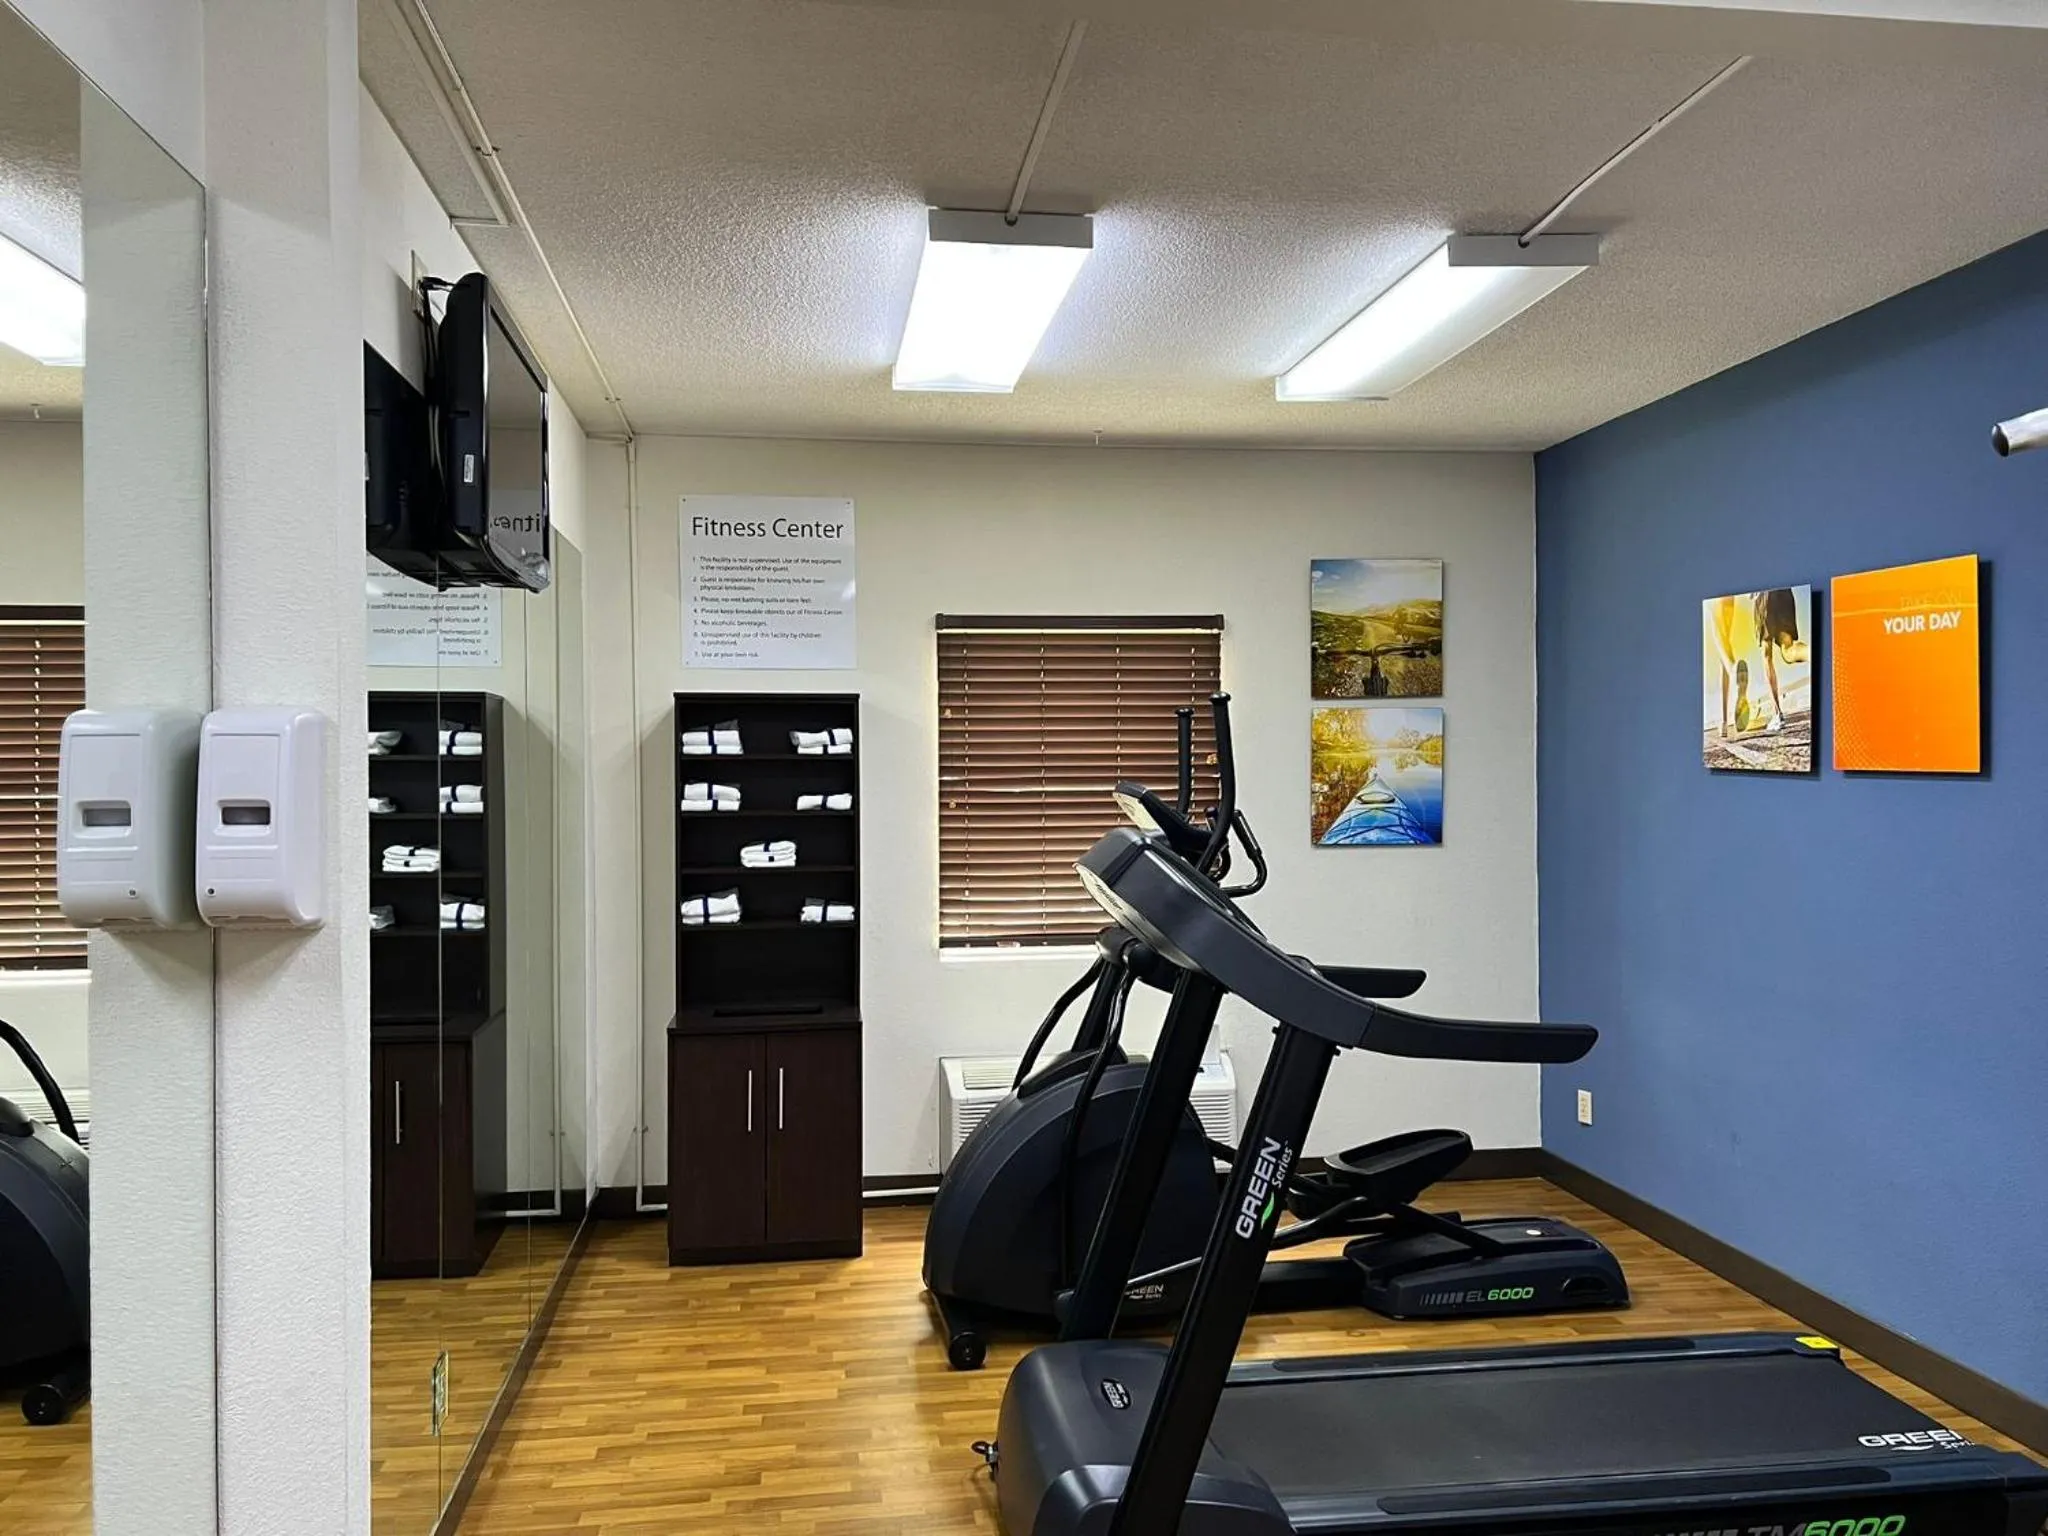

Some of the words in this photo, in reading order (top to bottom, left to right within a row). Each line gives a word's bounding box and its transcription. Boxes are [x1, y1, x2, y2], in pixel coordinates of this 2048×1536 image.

[692, 516, 766, 537] Fitness
[772, 518, 844, 538] Center
[1883, 614, 1926, 635] YOUR
[1928, 609, 1963, 631] DAY
[1271, 1147, 1294, 1189] Series
[1235, 1136, 1282, 1240] GREEN
